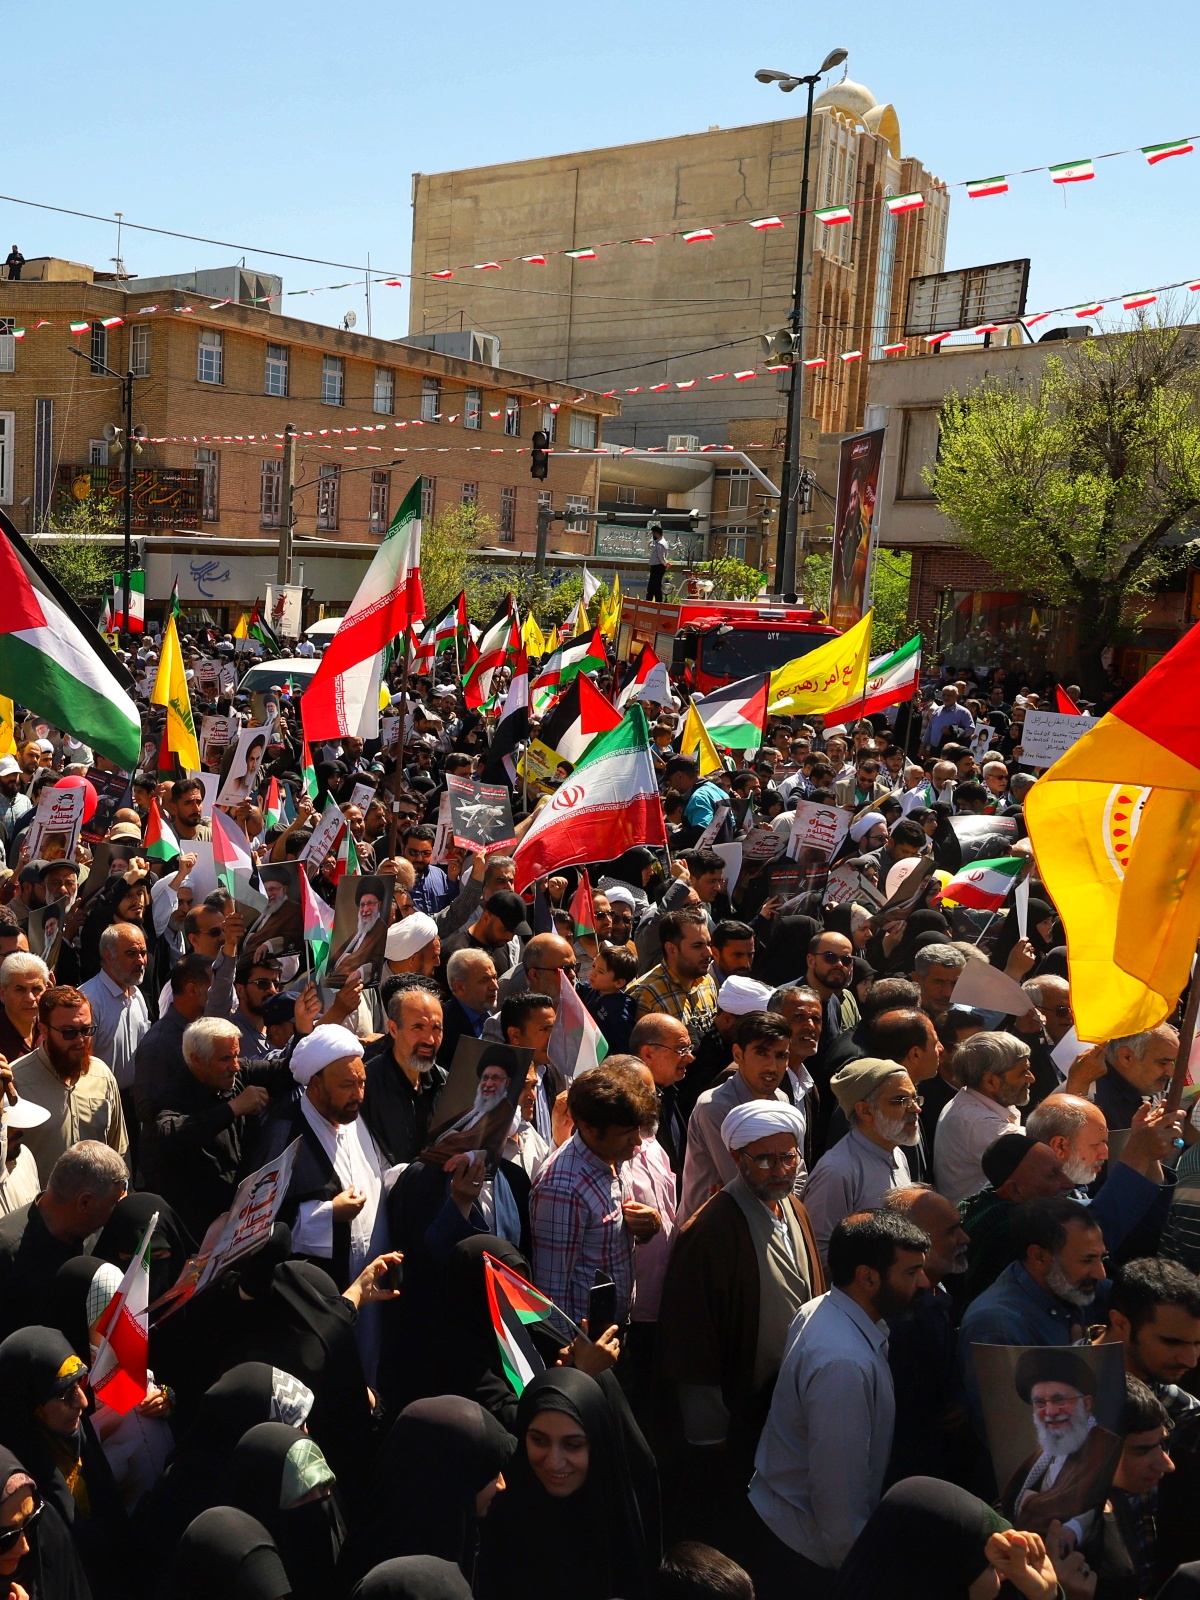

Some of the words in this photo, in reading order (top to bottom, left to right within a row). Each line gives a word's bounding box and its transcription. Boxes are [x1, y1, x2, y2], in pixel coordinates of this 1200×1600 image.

[821, 664, 840, 692] امر
[776, 679, 819, 701] رهبریم
[52, 800, 74, 813] غزه
[50, 811, 73, 820] مظلوم
[808, 817, 837, 833] غزه
[806, 828, 835, 839] مظلوم
[232, 1209, 273, 1239] مظلوم
